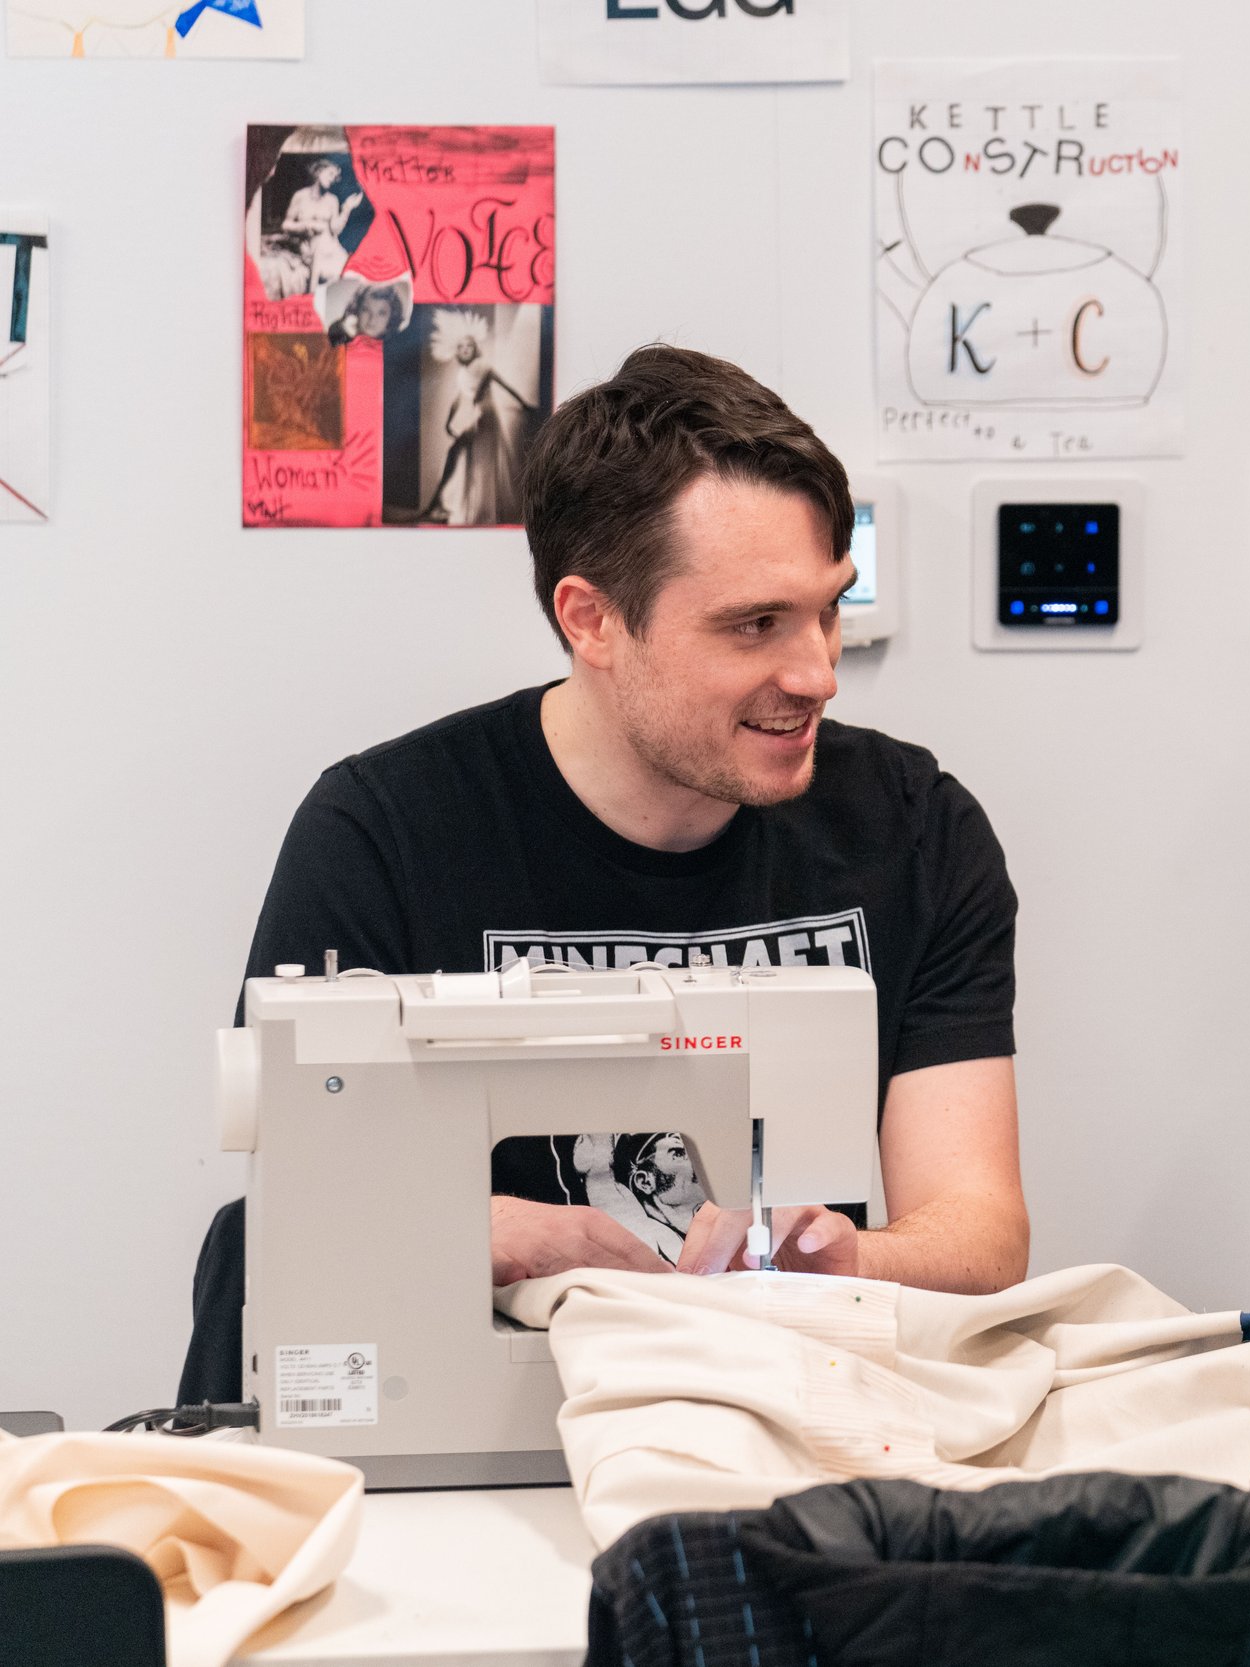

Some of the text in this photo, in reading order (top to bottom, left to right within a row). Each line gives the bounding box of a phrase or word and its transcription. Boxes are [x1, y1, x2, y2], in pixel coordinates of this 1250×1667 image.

[909, 103, 1110, 131] KETTLE
[949, 302, 996, 374] K
[1071, 299, 1110, 374] C
[660, 1035, 743, 1050] SINGER
